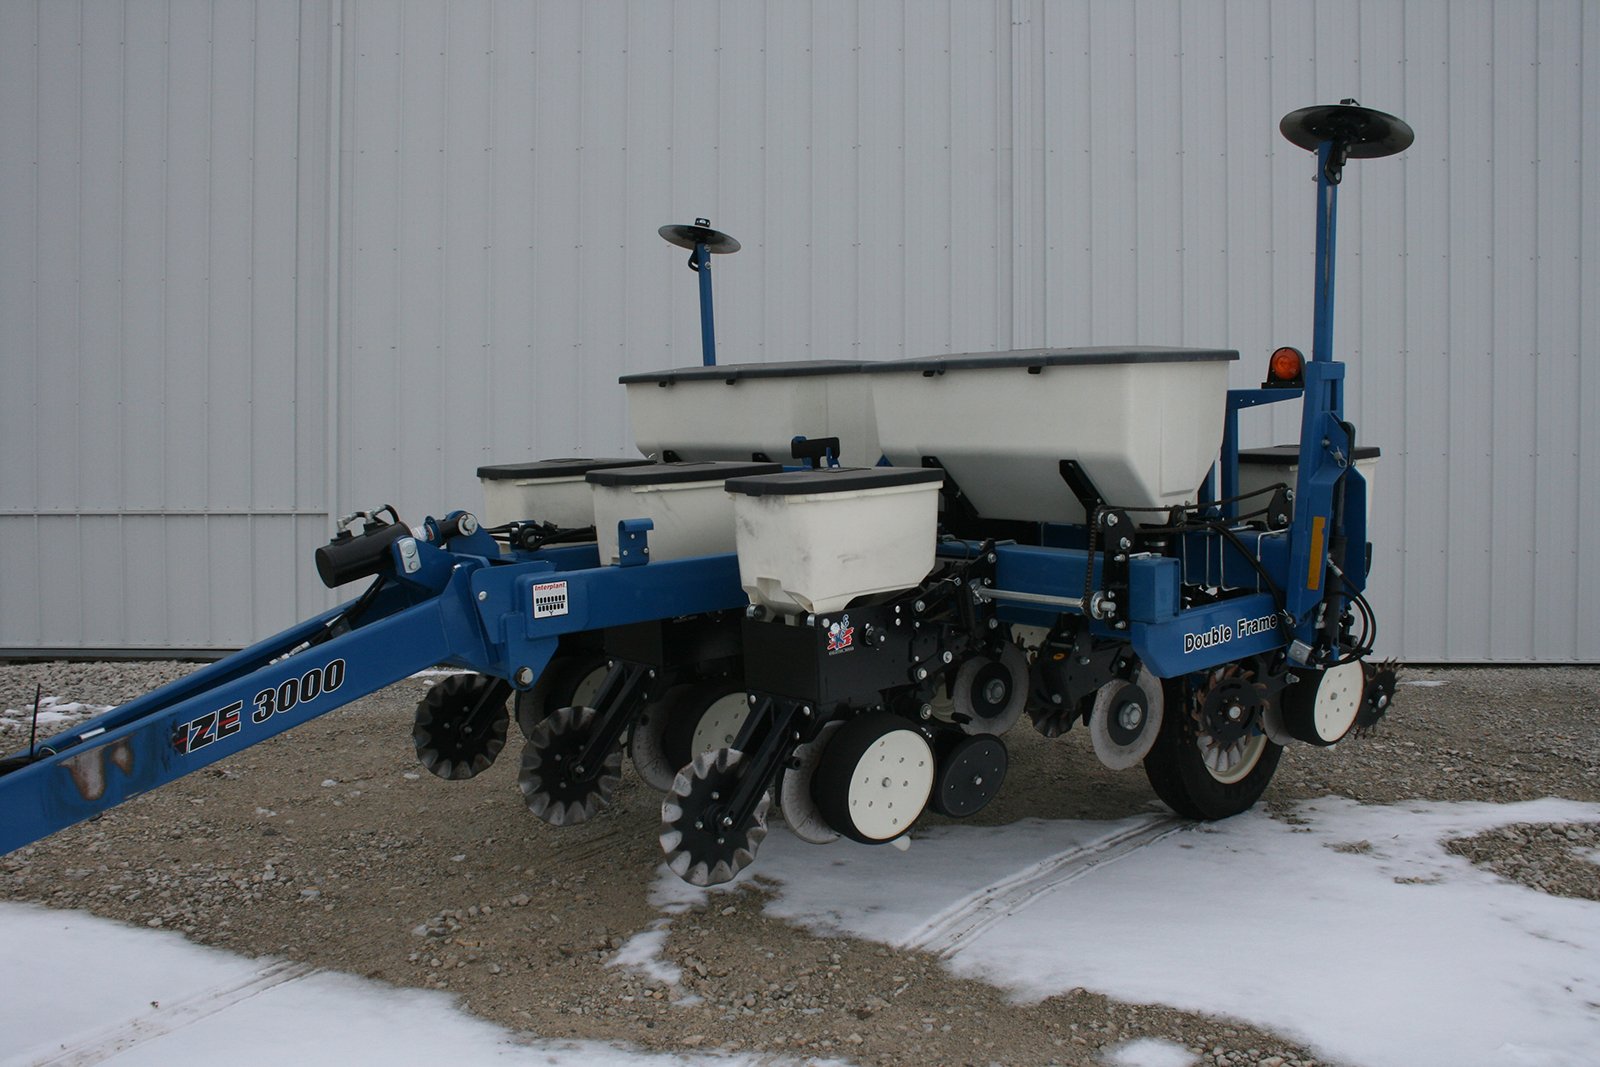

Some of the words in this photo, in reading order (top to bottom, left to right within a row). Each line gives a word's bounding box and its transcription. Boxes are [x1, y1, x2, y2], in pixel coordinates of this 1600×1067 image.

[534, 582, 566, 591] Interplant
[1184, 624, 1232, 654] Double
[1237, 613, 1278, 639] Frame
[252, 658, 346, 724] 3000
